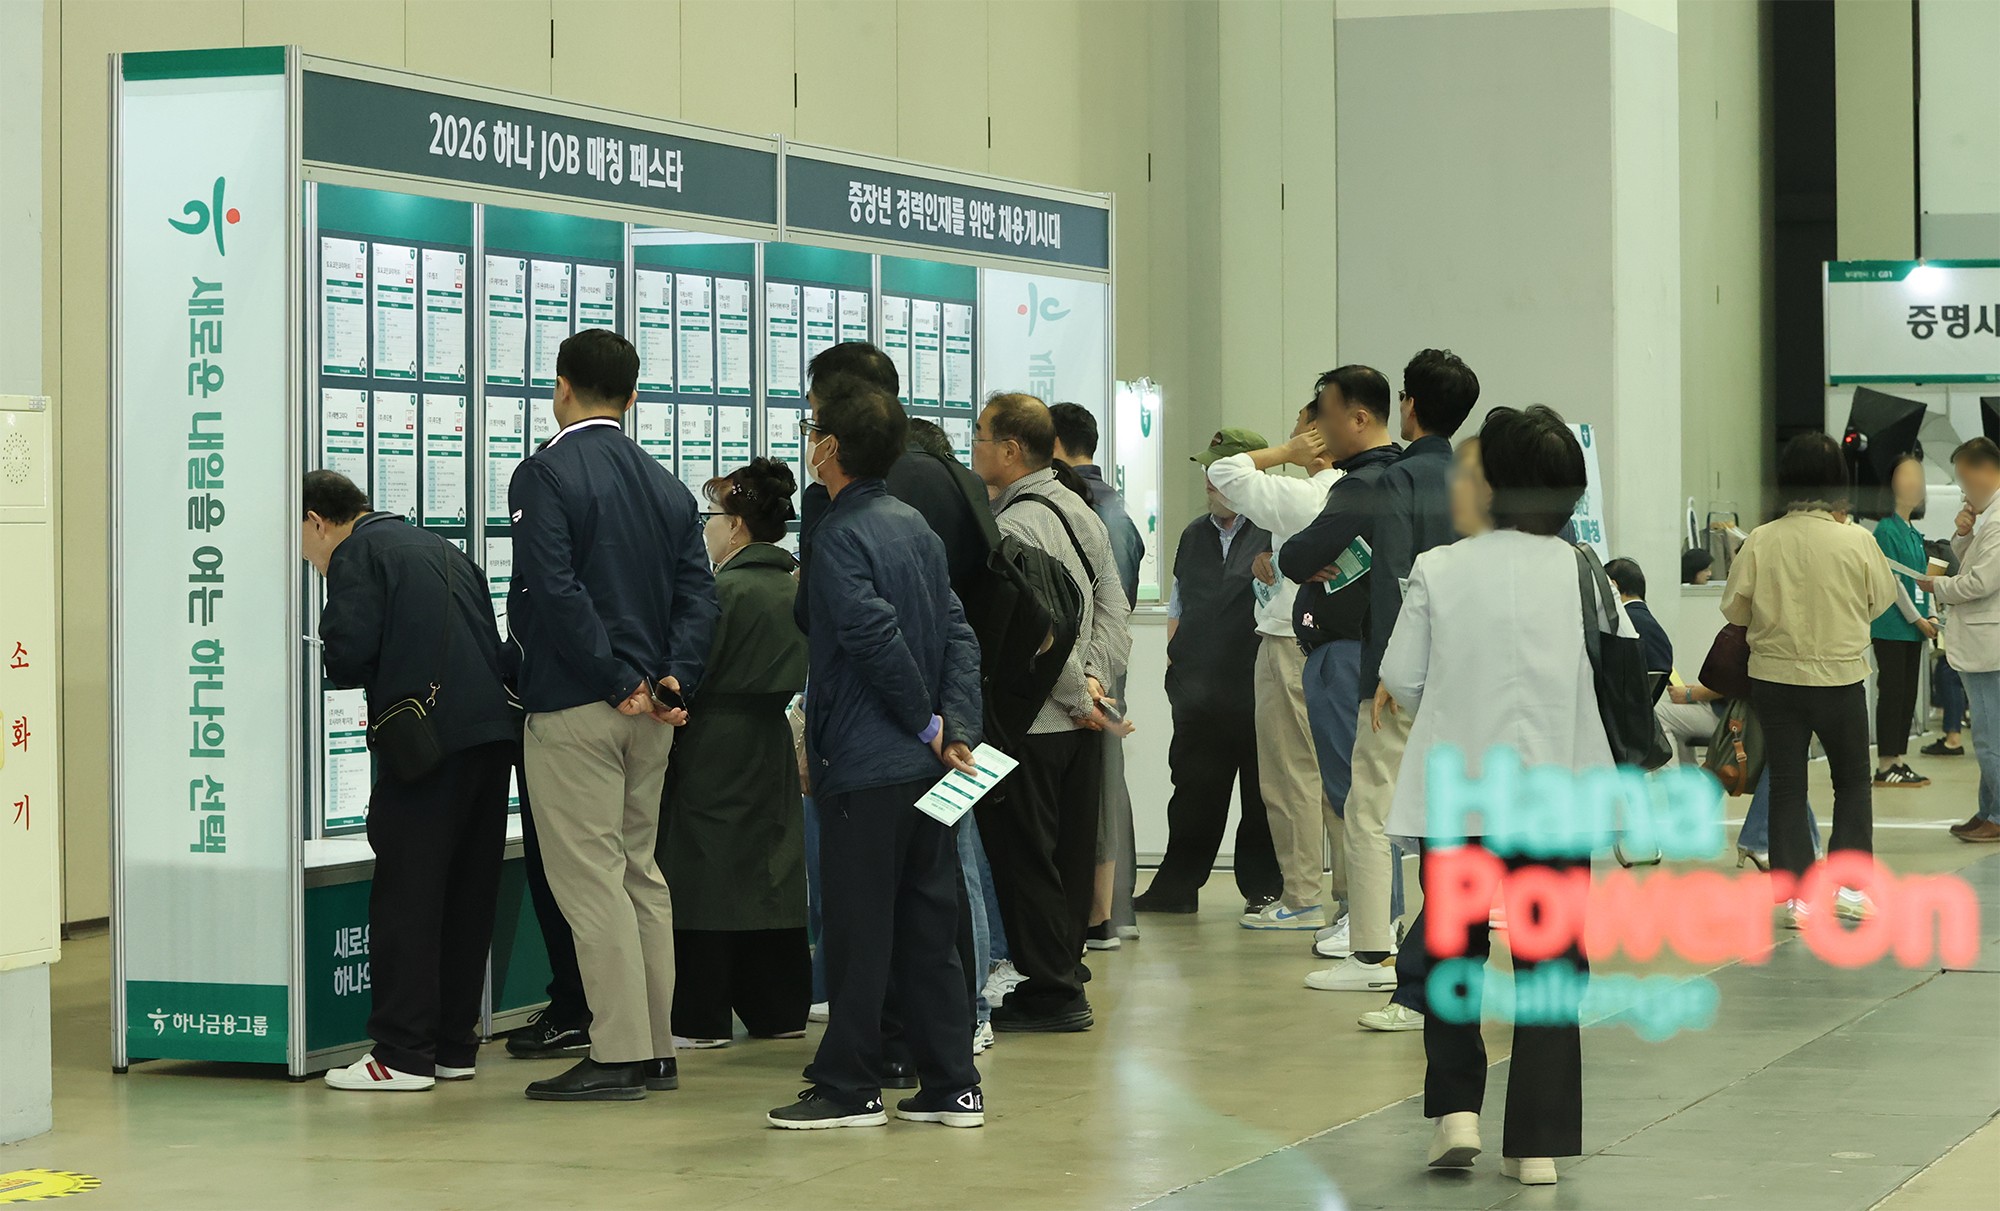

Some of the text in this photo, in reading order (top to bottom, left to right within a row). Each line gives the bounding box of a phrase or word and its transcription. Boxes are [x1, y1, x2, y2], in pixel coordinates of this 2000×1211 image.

[429, 112, 684, 193] 2026 하나 JOB 매칭 페스타
[848, 181, 1061, 249] 중장년 경력인재를 위한 채용게시대
[188, 276, 226, 853] 새로운 내일을 여는 하나의 선택
[1425, 744, 1727, 862] Hana
[1423, 844, 1981, 969] PowerOn
[172, 1012, 269, 1037] 하나금융그룹
